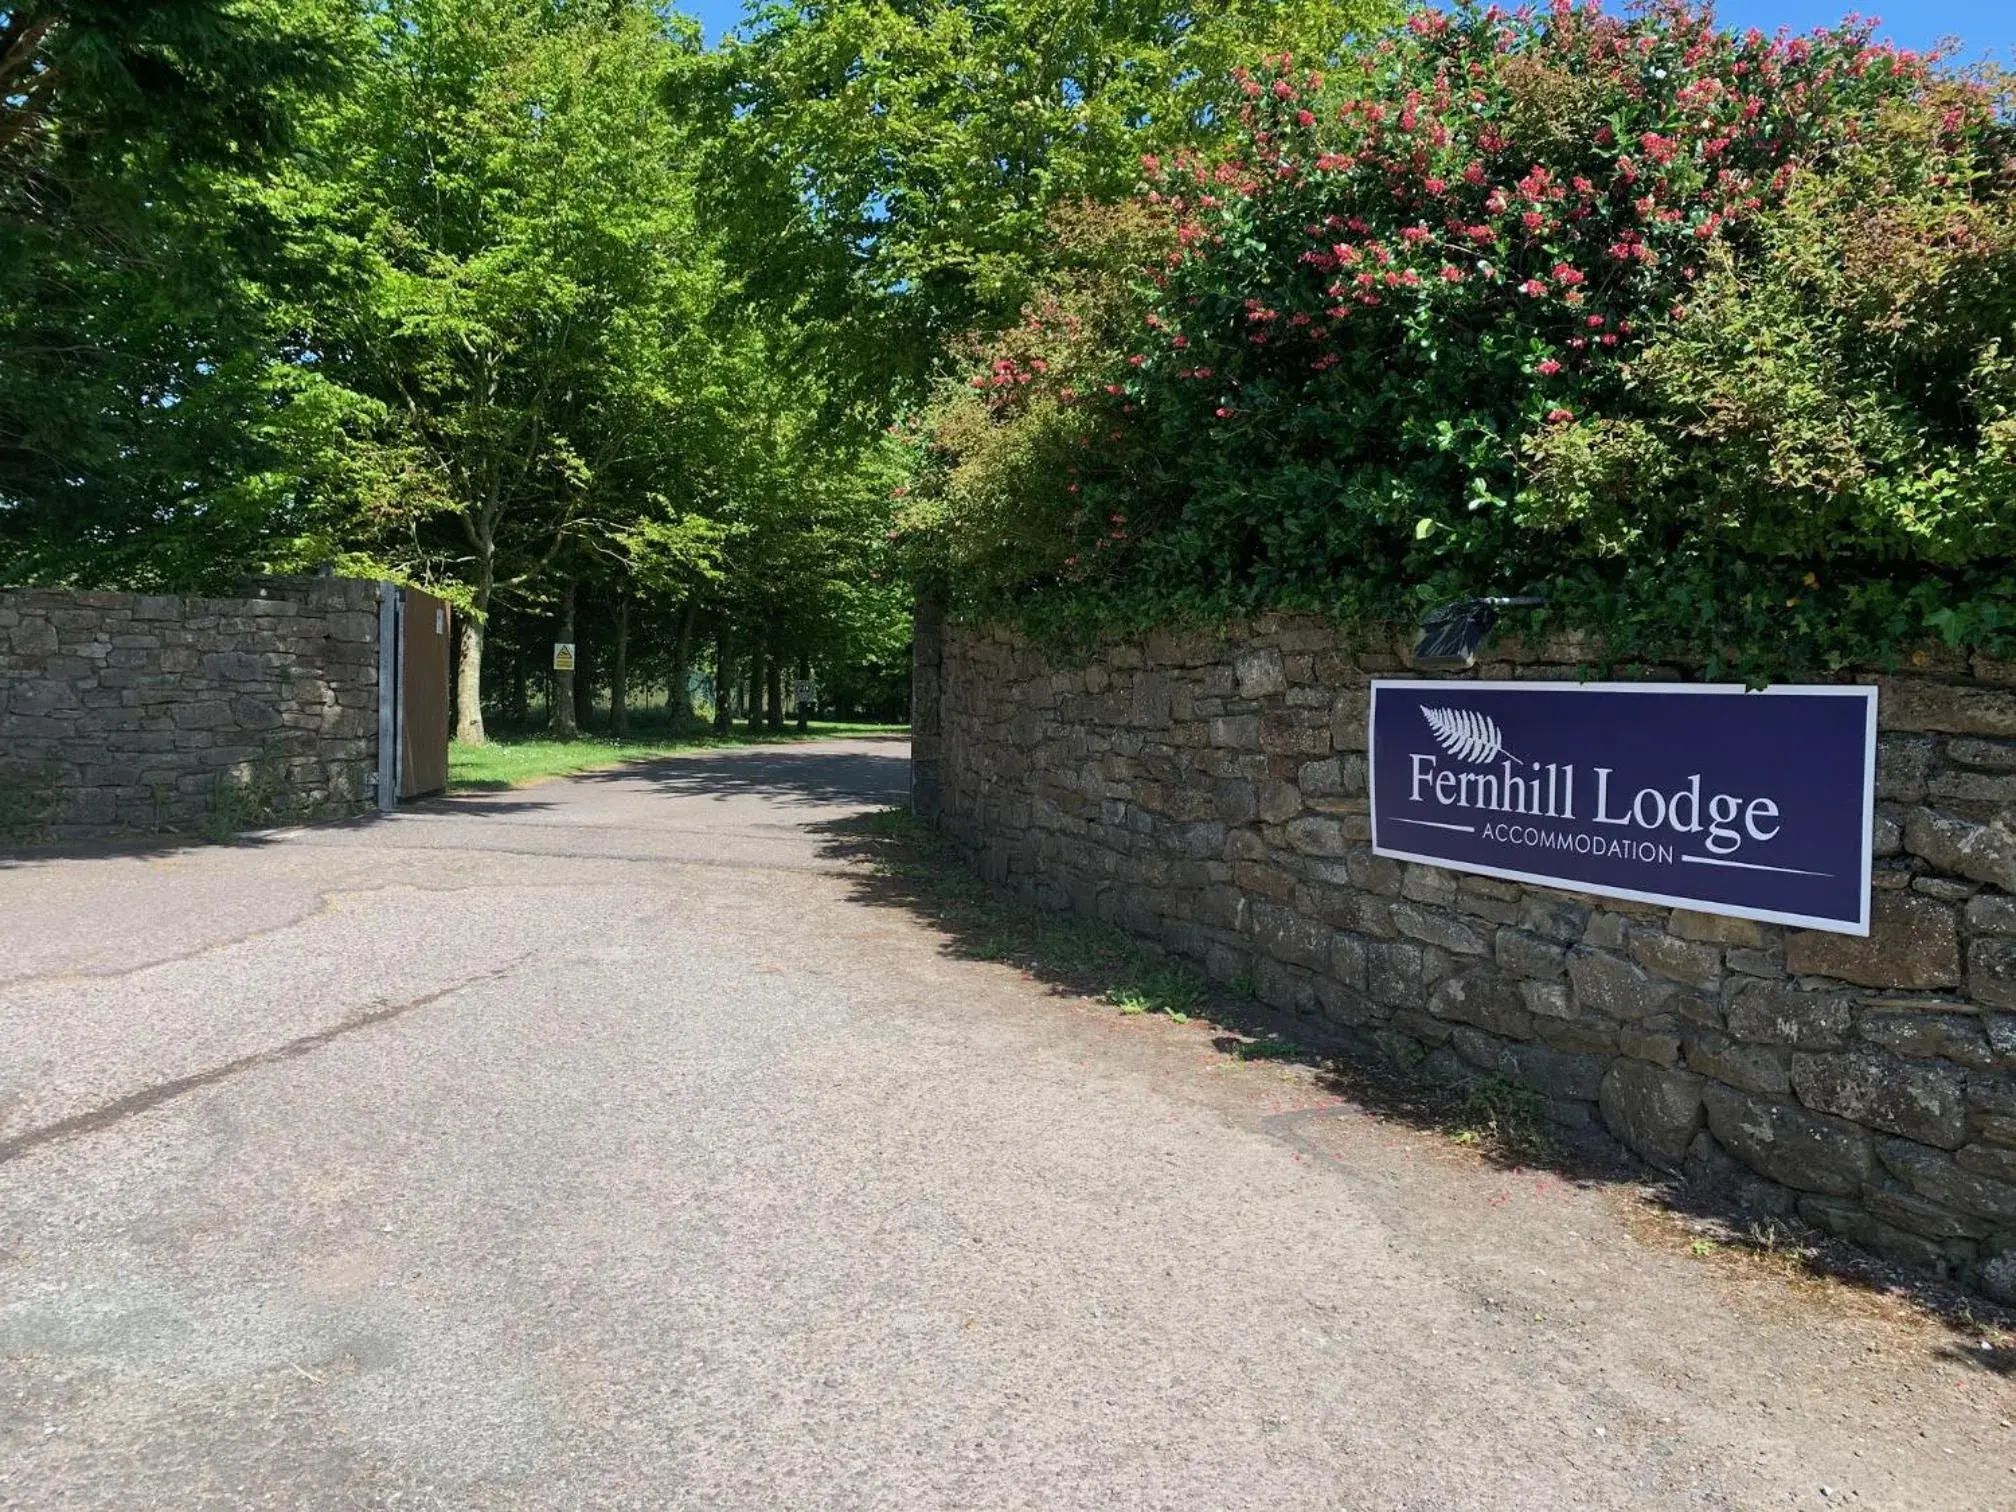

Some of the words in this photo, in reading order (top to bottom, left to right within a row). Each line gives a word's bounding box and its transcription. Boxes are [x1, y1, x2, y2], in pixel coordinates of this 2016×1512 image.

[1408, 753, 1577, 820] Fernhill
[1593, 767, 1781, 854] Lodge
[1481, 822, 1674, 865] ACCOMMODATION
